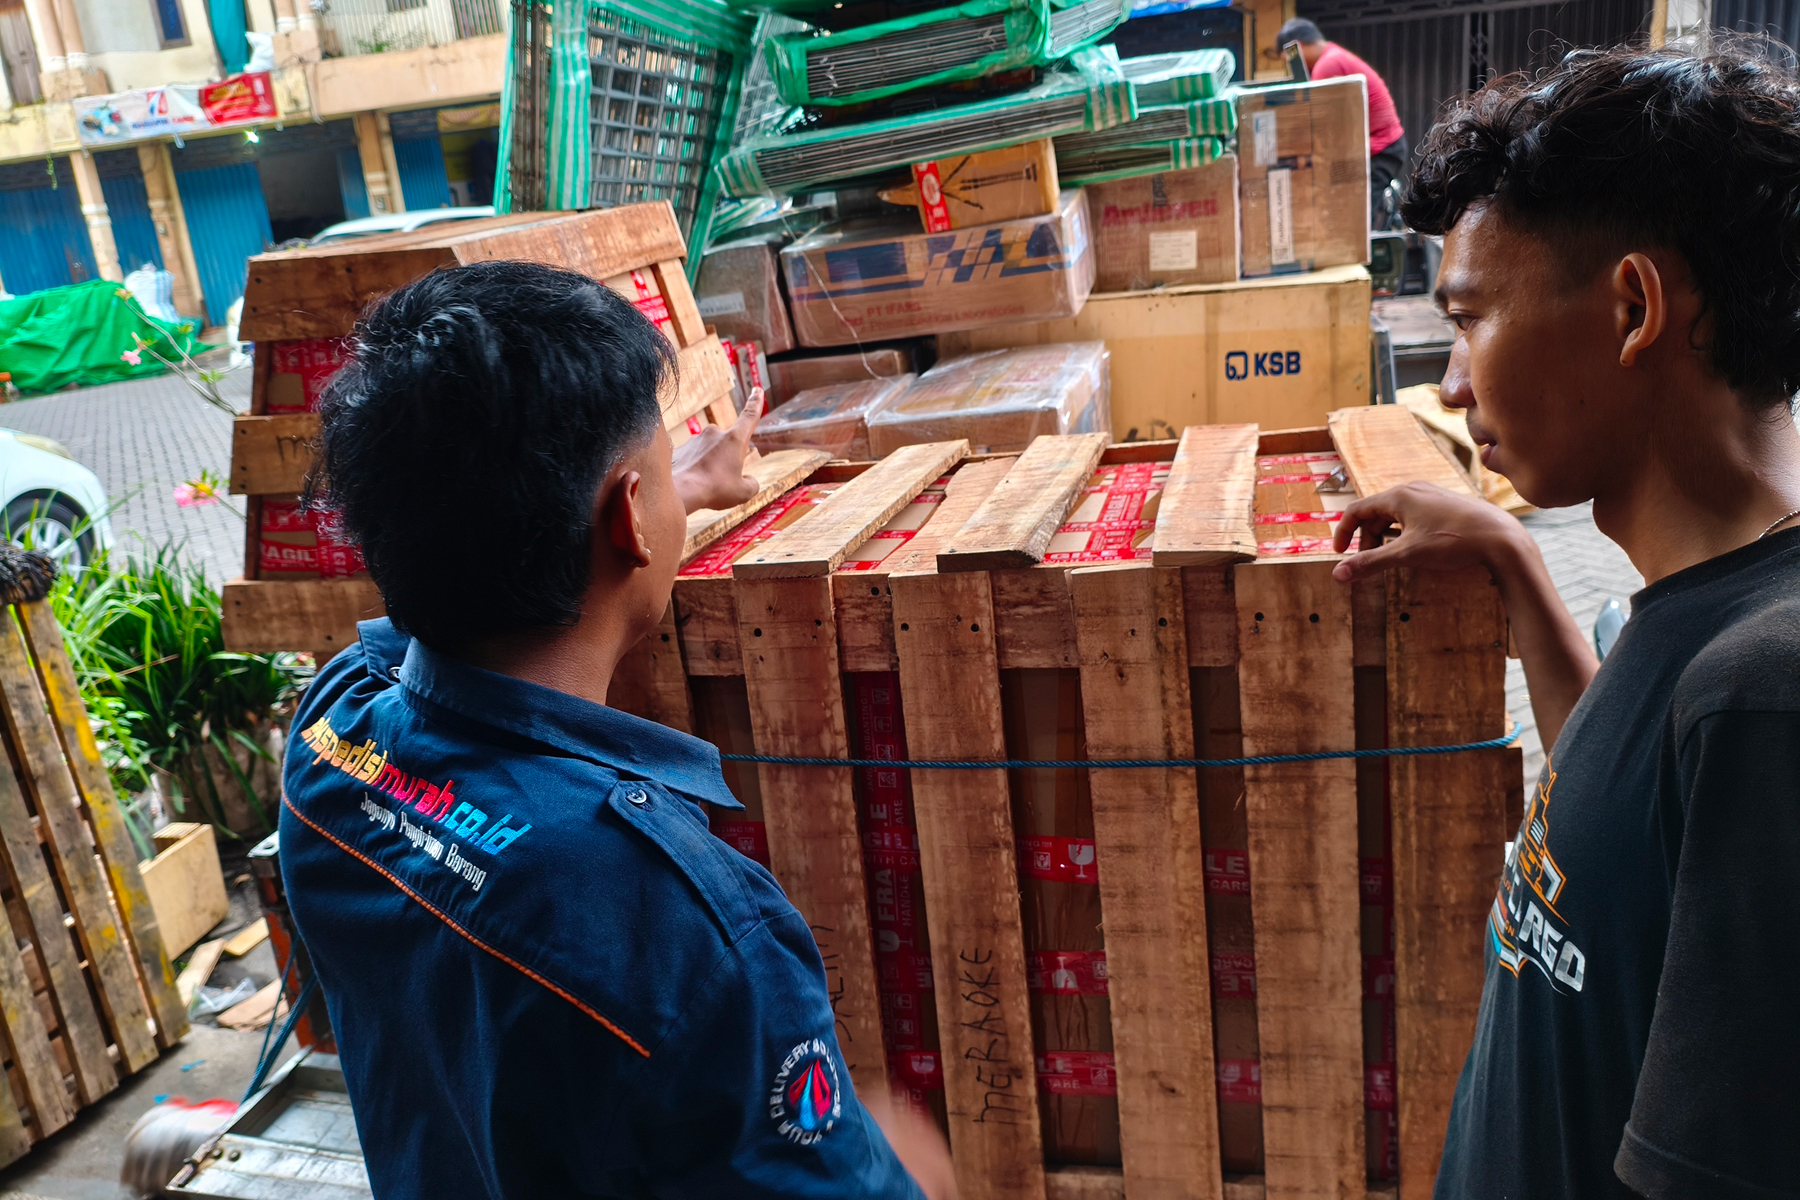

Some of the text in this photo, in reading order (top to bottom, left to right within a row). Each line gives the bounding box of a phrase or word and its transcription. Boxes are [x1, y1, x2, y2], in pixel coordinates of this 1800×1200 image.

[1254, 351, 1301, 376] KSB
[445, 843, 487, 892] Barang
[769, 1039, 811, 1119] DELIVERY
